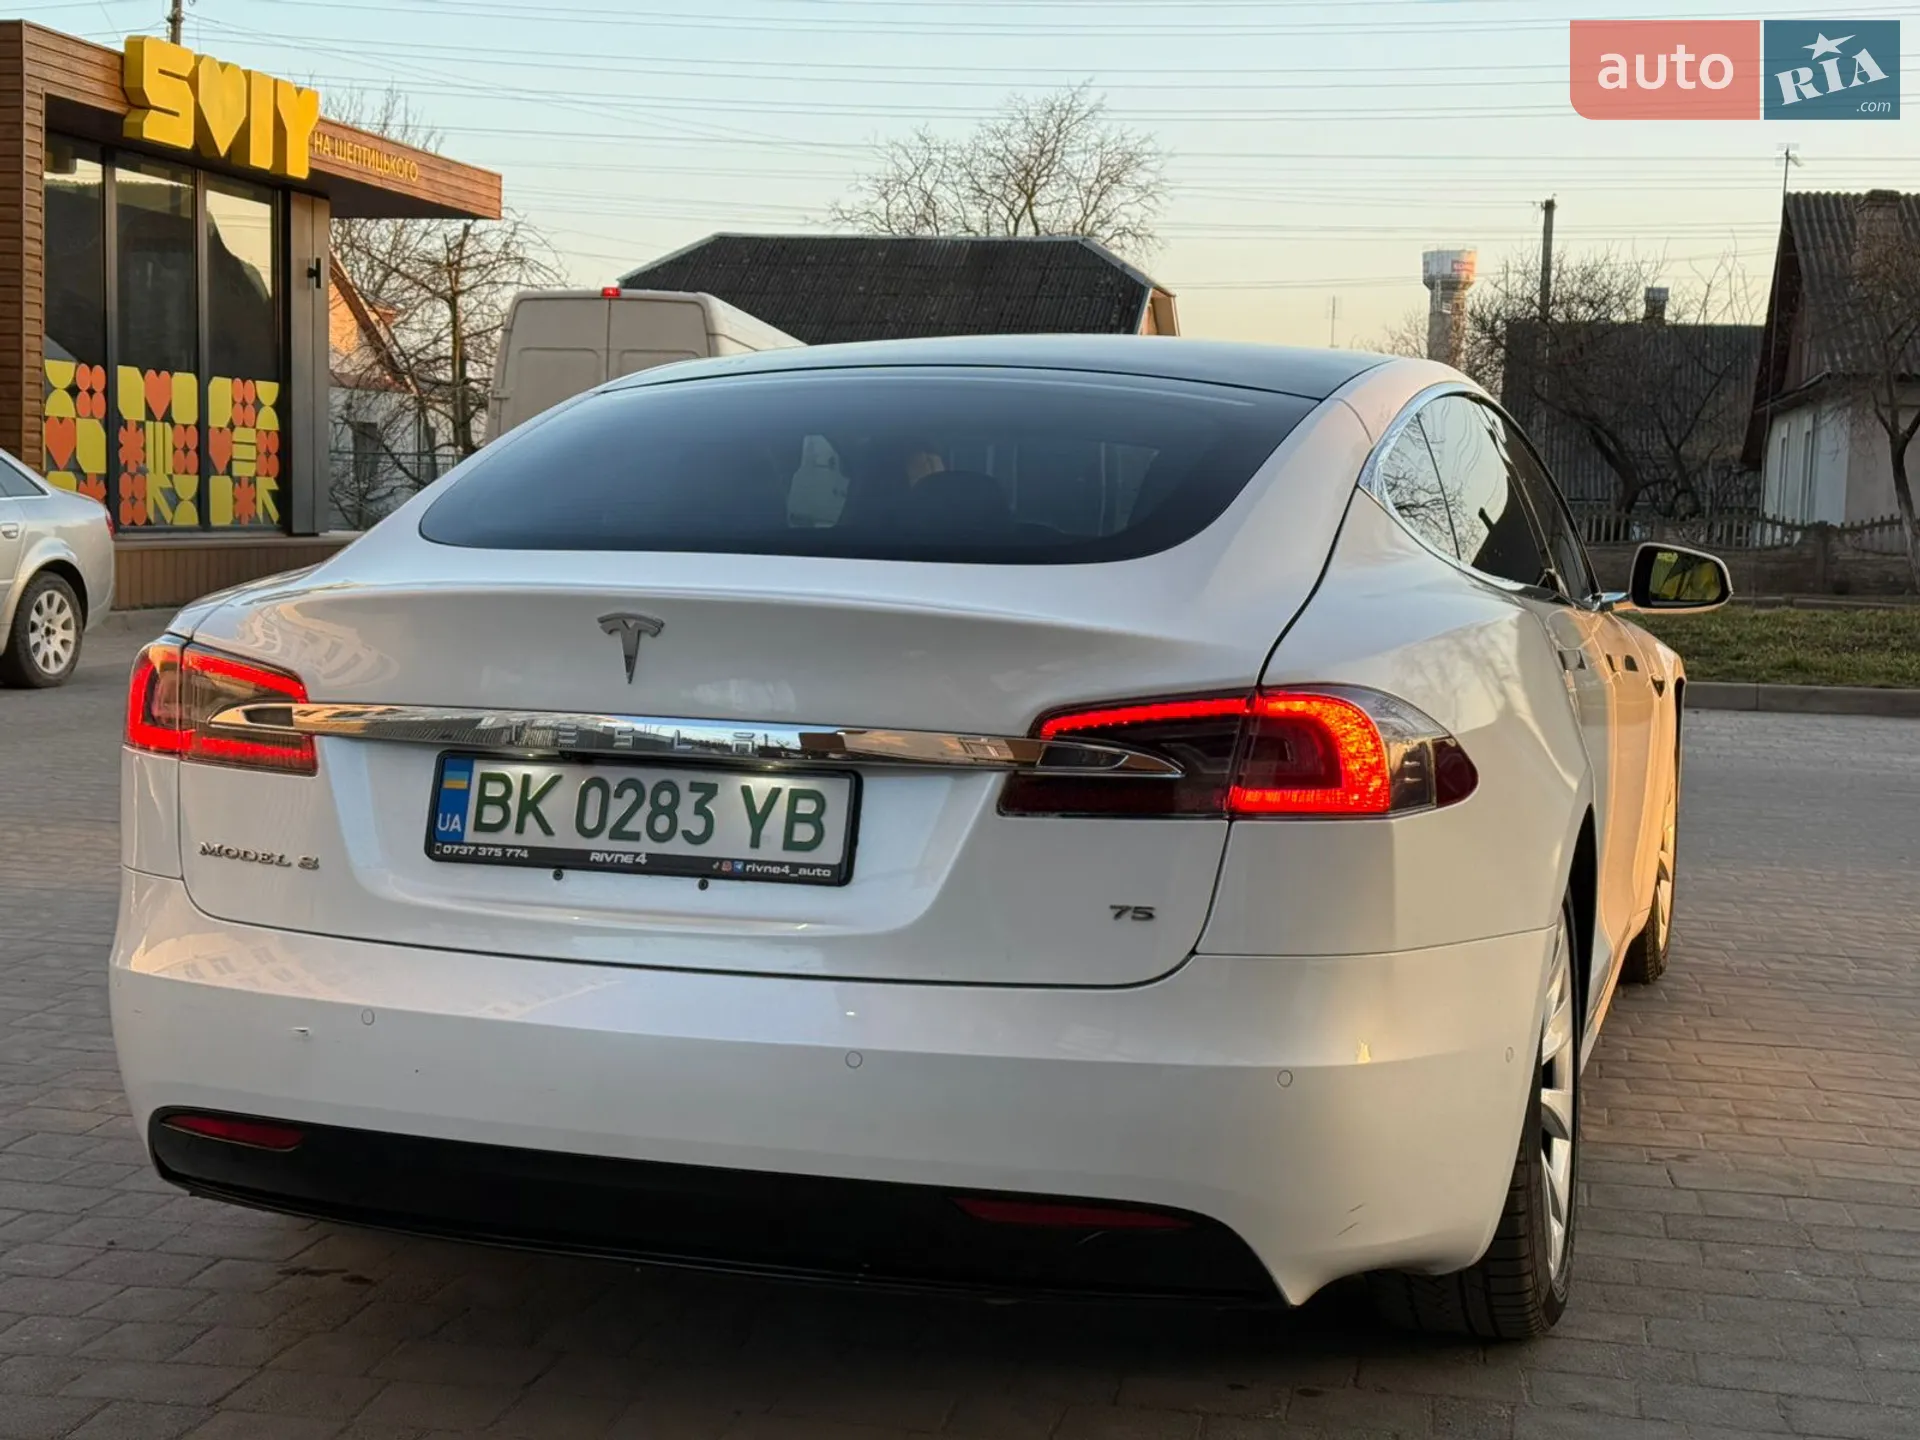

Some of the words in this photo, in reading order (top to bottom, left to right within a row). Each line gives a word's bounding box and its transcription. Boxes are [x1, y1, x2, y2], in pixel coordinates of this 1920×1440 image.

[314, 131, 333, 157] НА
[335, 138, 419, 182] ШЕПТИЦЬКОГО
[473, 771, 562, 837] BK
[574, 777, 720, 845] 0283
[740, 784, 827, 852] YB
[437, 812, 462, 834] UA
[199, 841, 292, 867] MODEL
[298, 855, 320, 870] S
[442, 844, 475, 855] 0737
[477, 847, 503, 857] 375
[504, 848, 529, 858] 774
[745, 863, 832, 877] rivne4_auto
[1109, 904, 1156, 921] 75
